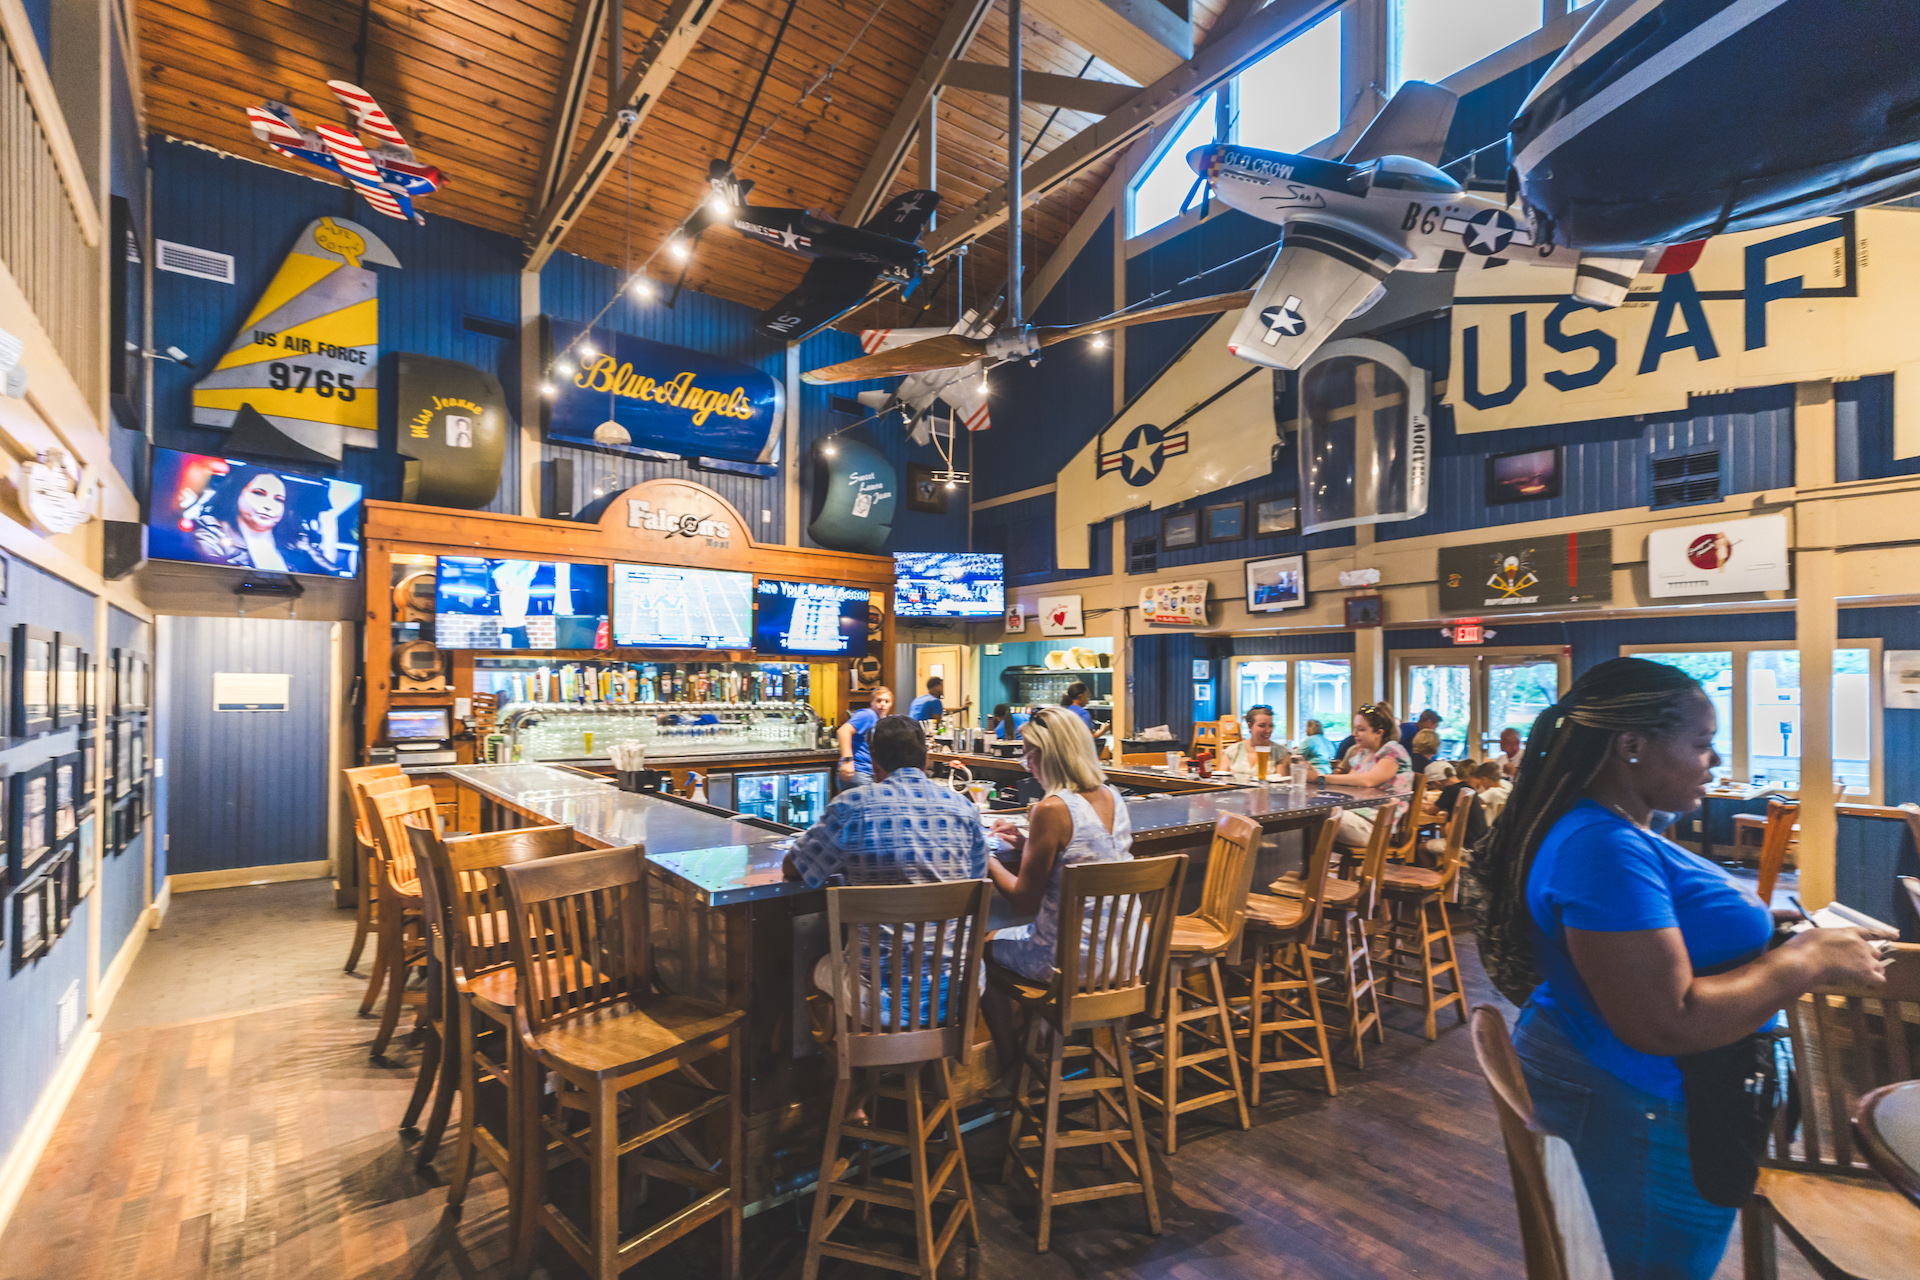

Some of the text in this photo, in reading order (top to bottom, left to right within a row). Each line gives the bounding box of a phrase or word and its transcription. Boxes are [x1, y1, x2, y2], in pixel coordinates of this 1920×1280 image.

[1224, 151, 1296, 181] OLD CROW
[734, 219, 769, 236] MARINES
[1401, 202, 1441, 235] B6
[894, 265, 911, 279] 34
[1462, 217, 1846, 411] USAF
[254, 330, 367, 366] US AIR FORCE
[269, 361, 356, 402] 9765
[574, 351, 753, 427] Blue Angels
